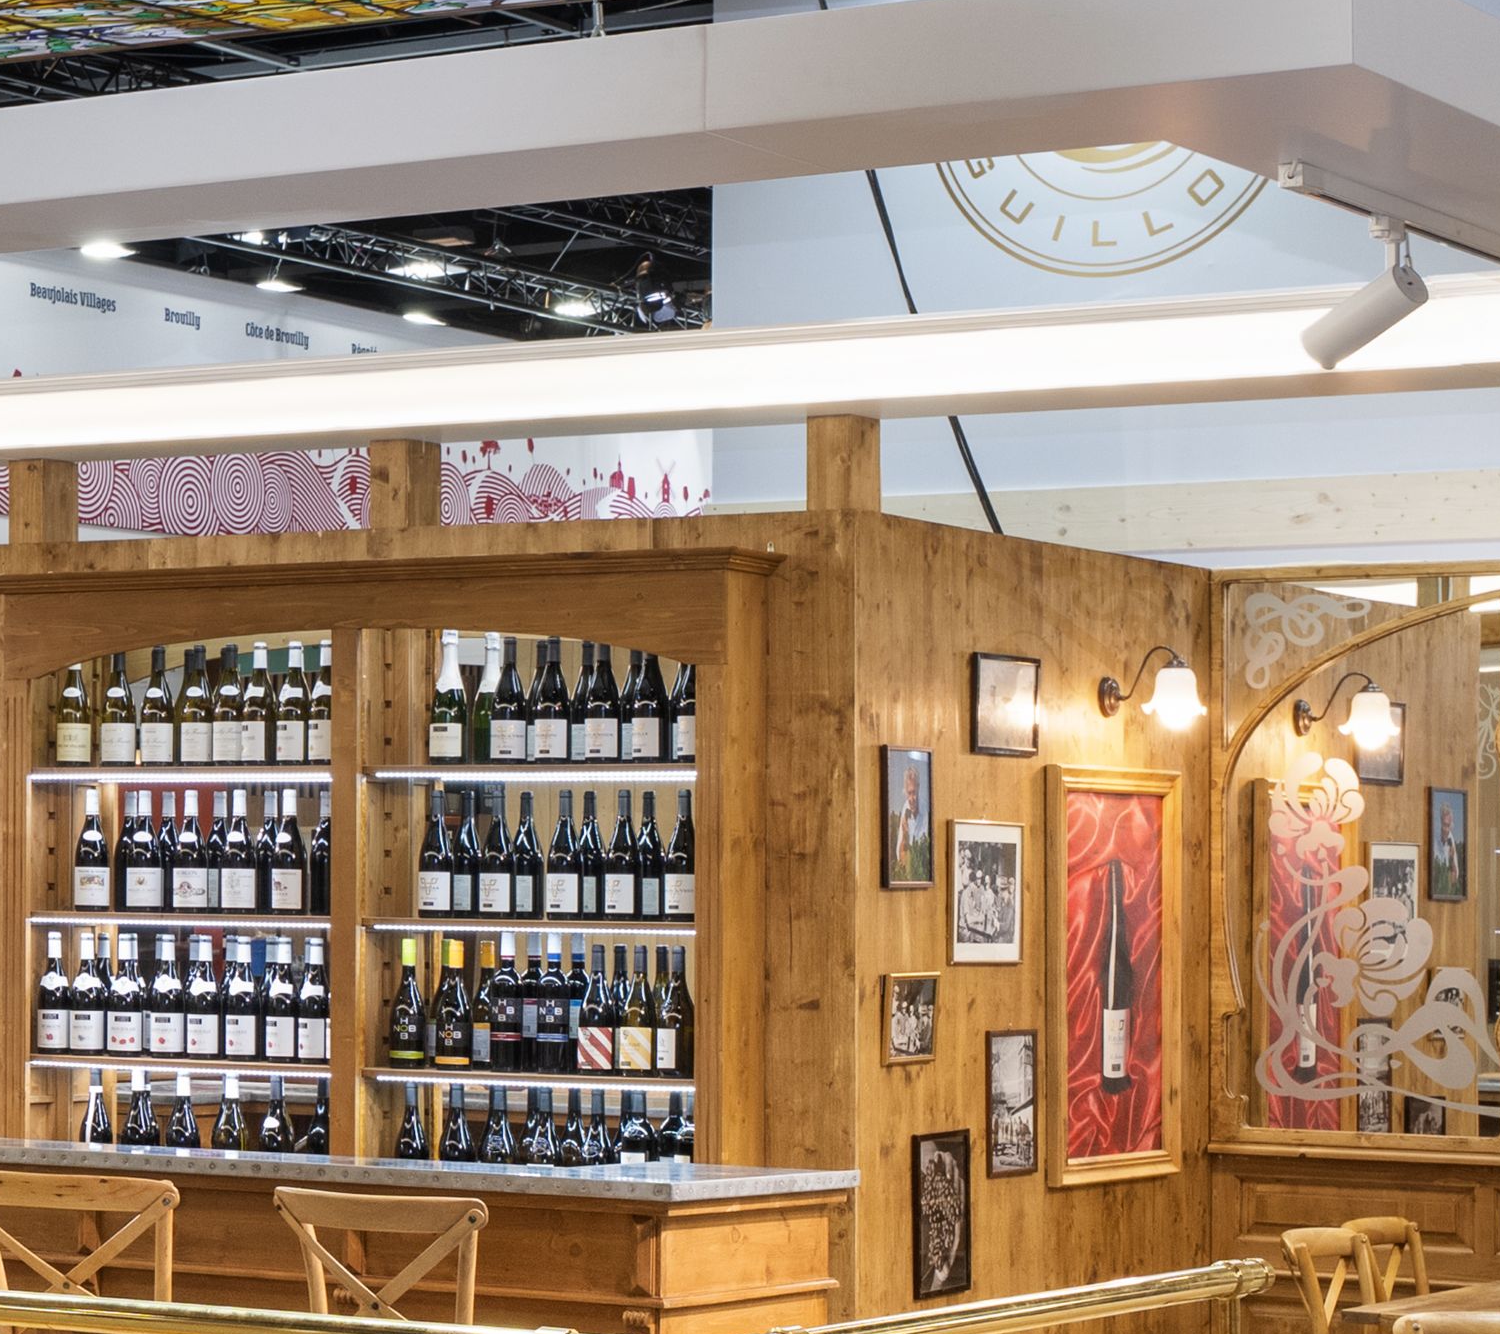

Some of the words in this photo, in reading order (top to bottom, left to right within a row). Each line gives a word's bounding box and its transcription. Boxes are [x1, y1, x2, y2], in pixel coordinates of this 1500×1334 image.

[30, 282, 78, 305] Beaujolais
[79, 291, 116, 314] Villages
[164, 308, 200, 330] Brouilly
[245, 322, 264, 340] Côte
[264, 326, 275, 341] de
[275, 328, 309, 351] Brouilly
